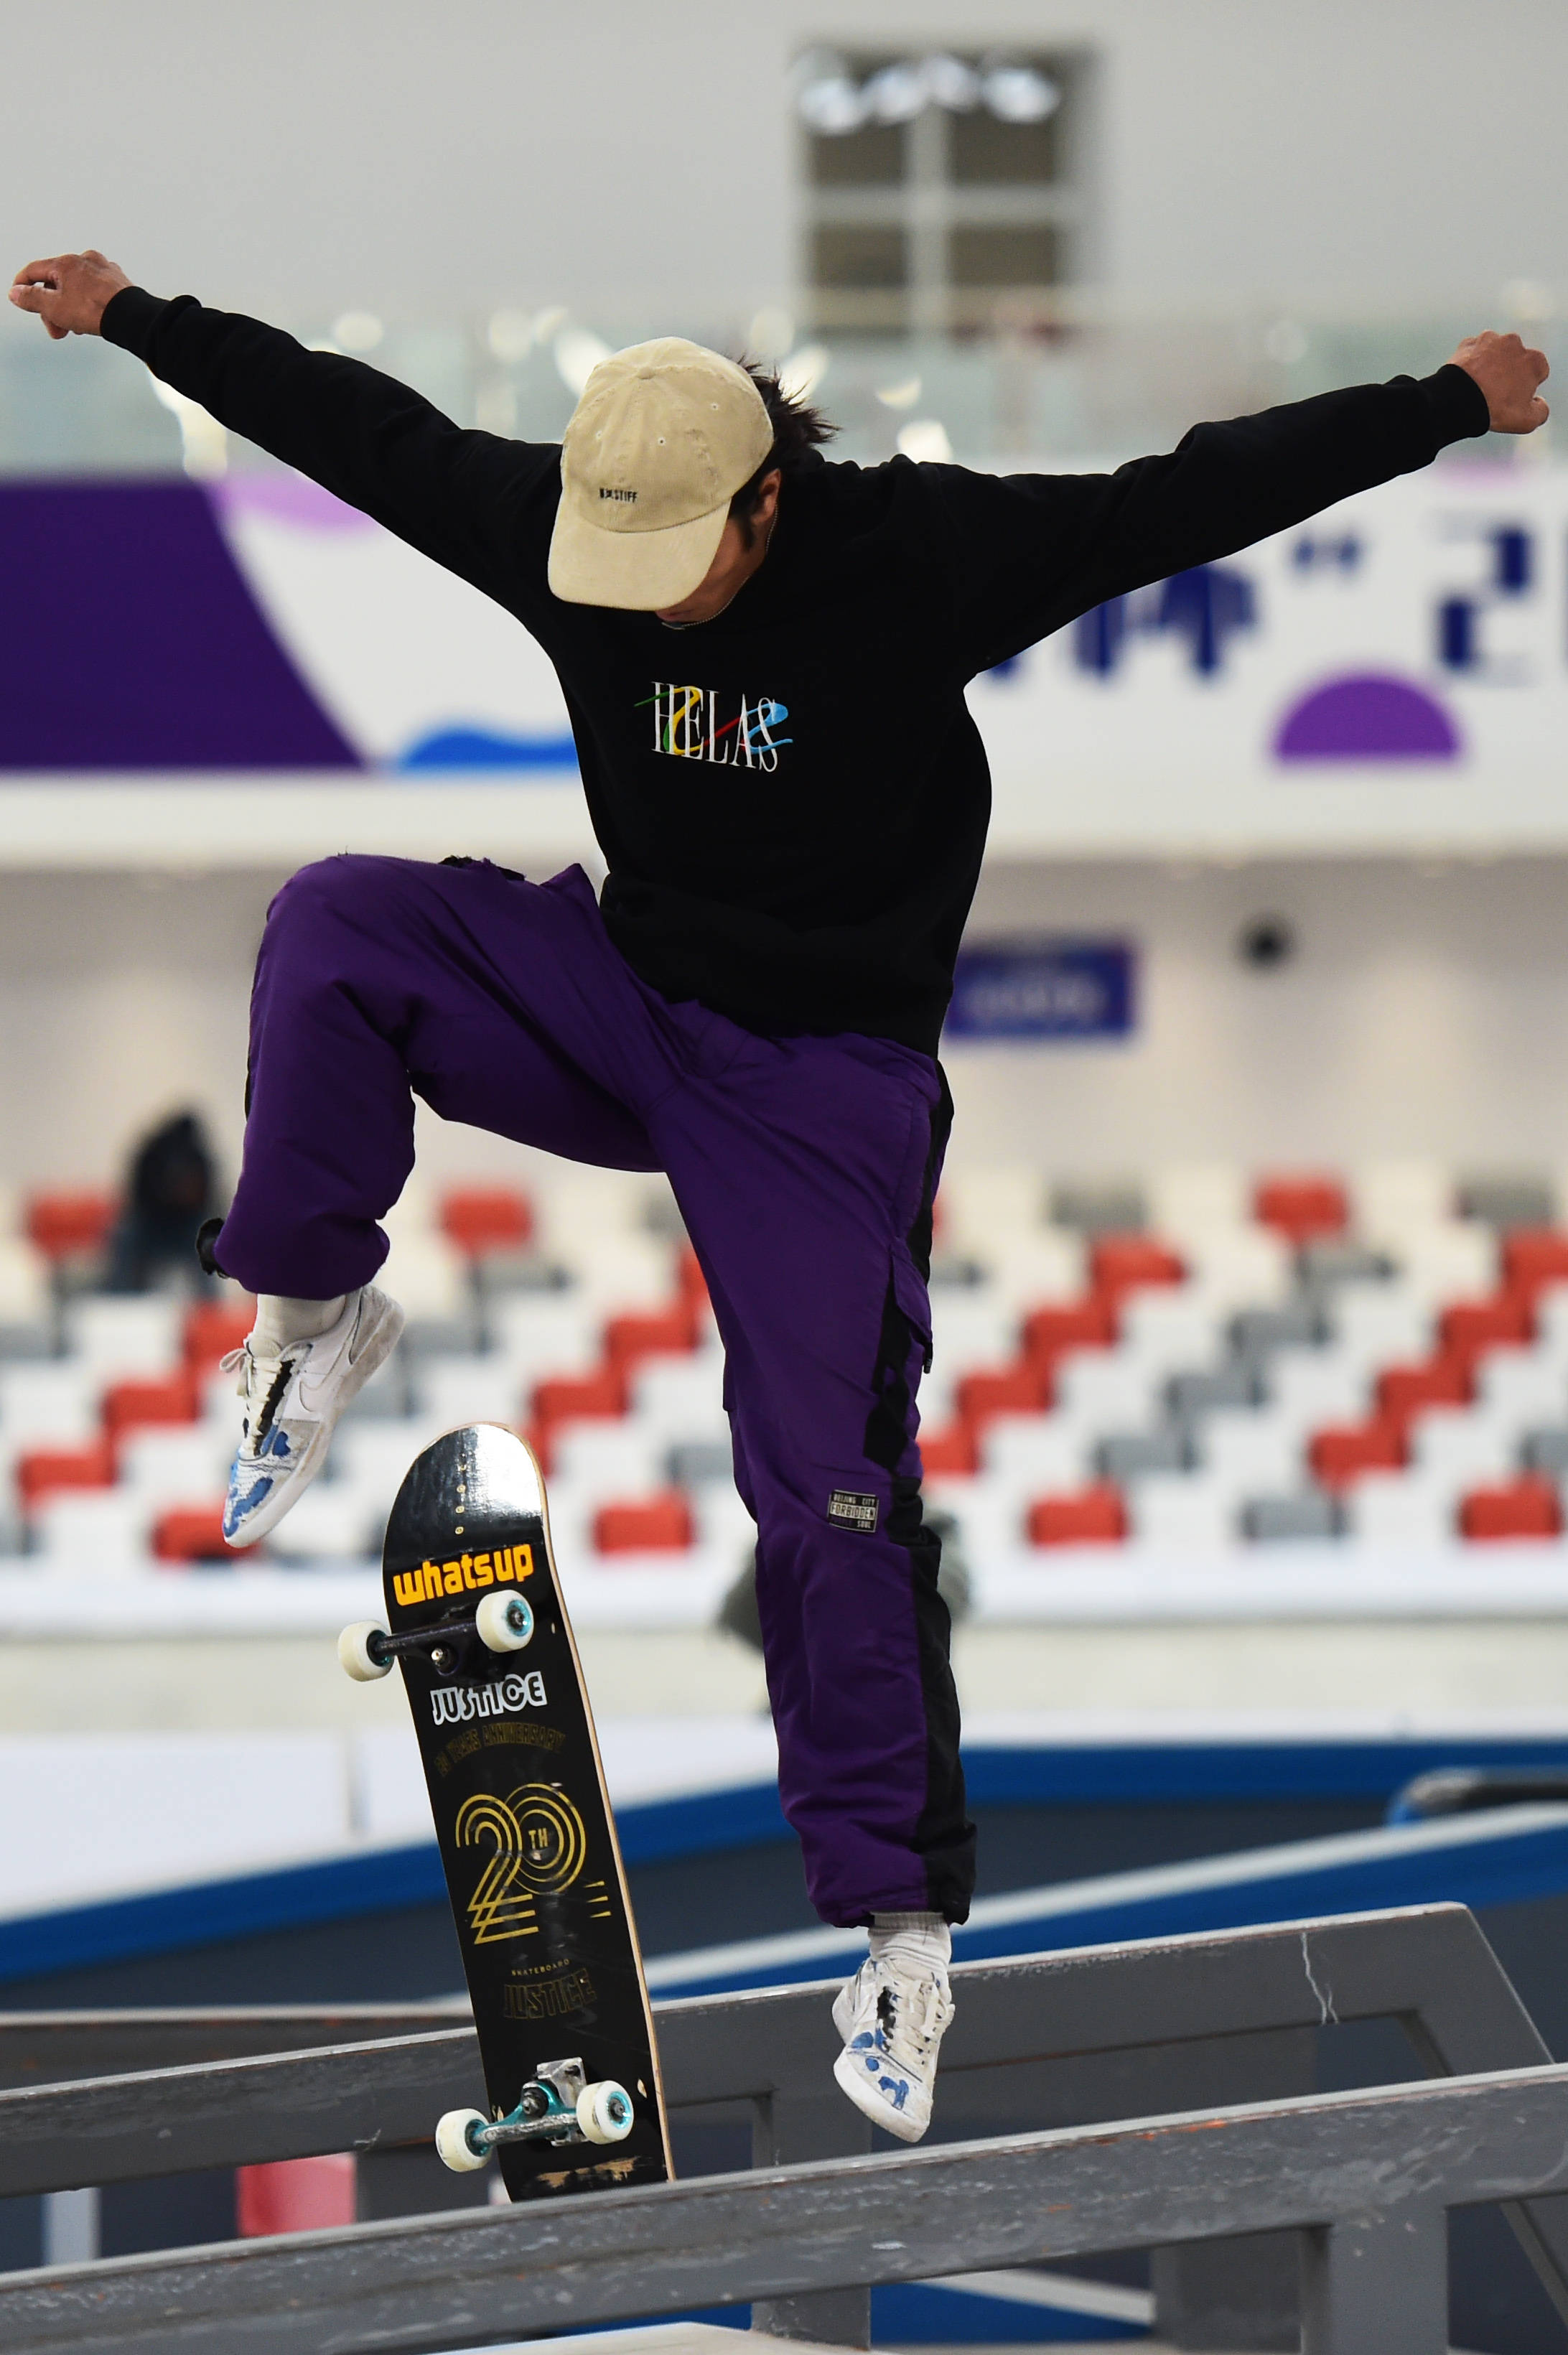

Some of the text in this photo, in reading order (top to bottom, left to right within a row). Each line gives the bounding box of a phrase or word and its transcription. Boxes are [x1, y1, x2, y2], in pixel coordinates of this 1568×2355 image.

[650, 681, 779, 773] HELAS
[831, 1503, 875, 1519] FORBIDDEN
[862, 1497, 875, 1506] CITY
[393, 1543, 534, 1607] whatsup
[429, 1670, 548, 1726] JUSTICE
[482, 1721, 566, 1755] ANNIVERSARY
[528, 1827, 549, 1850] TH
[510, 1958, 571, 1977] SKATEBOARD
[504, 1967, 597, 2020] JUSTICE
